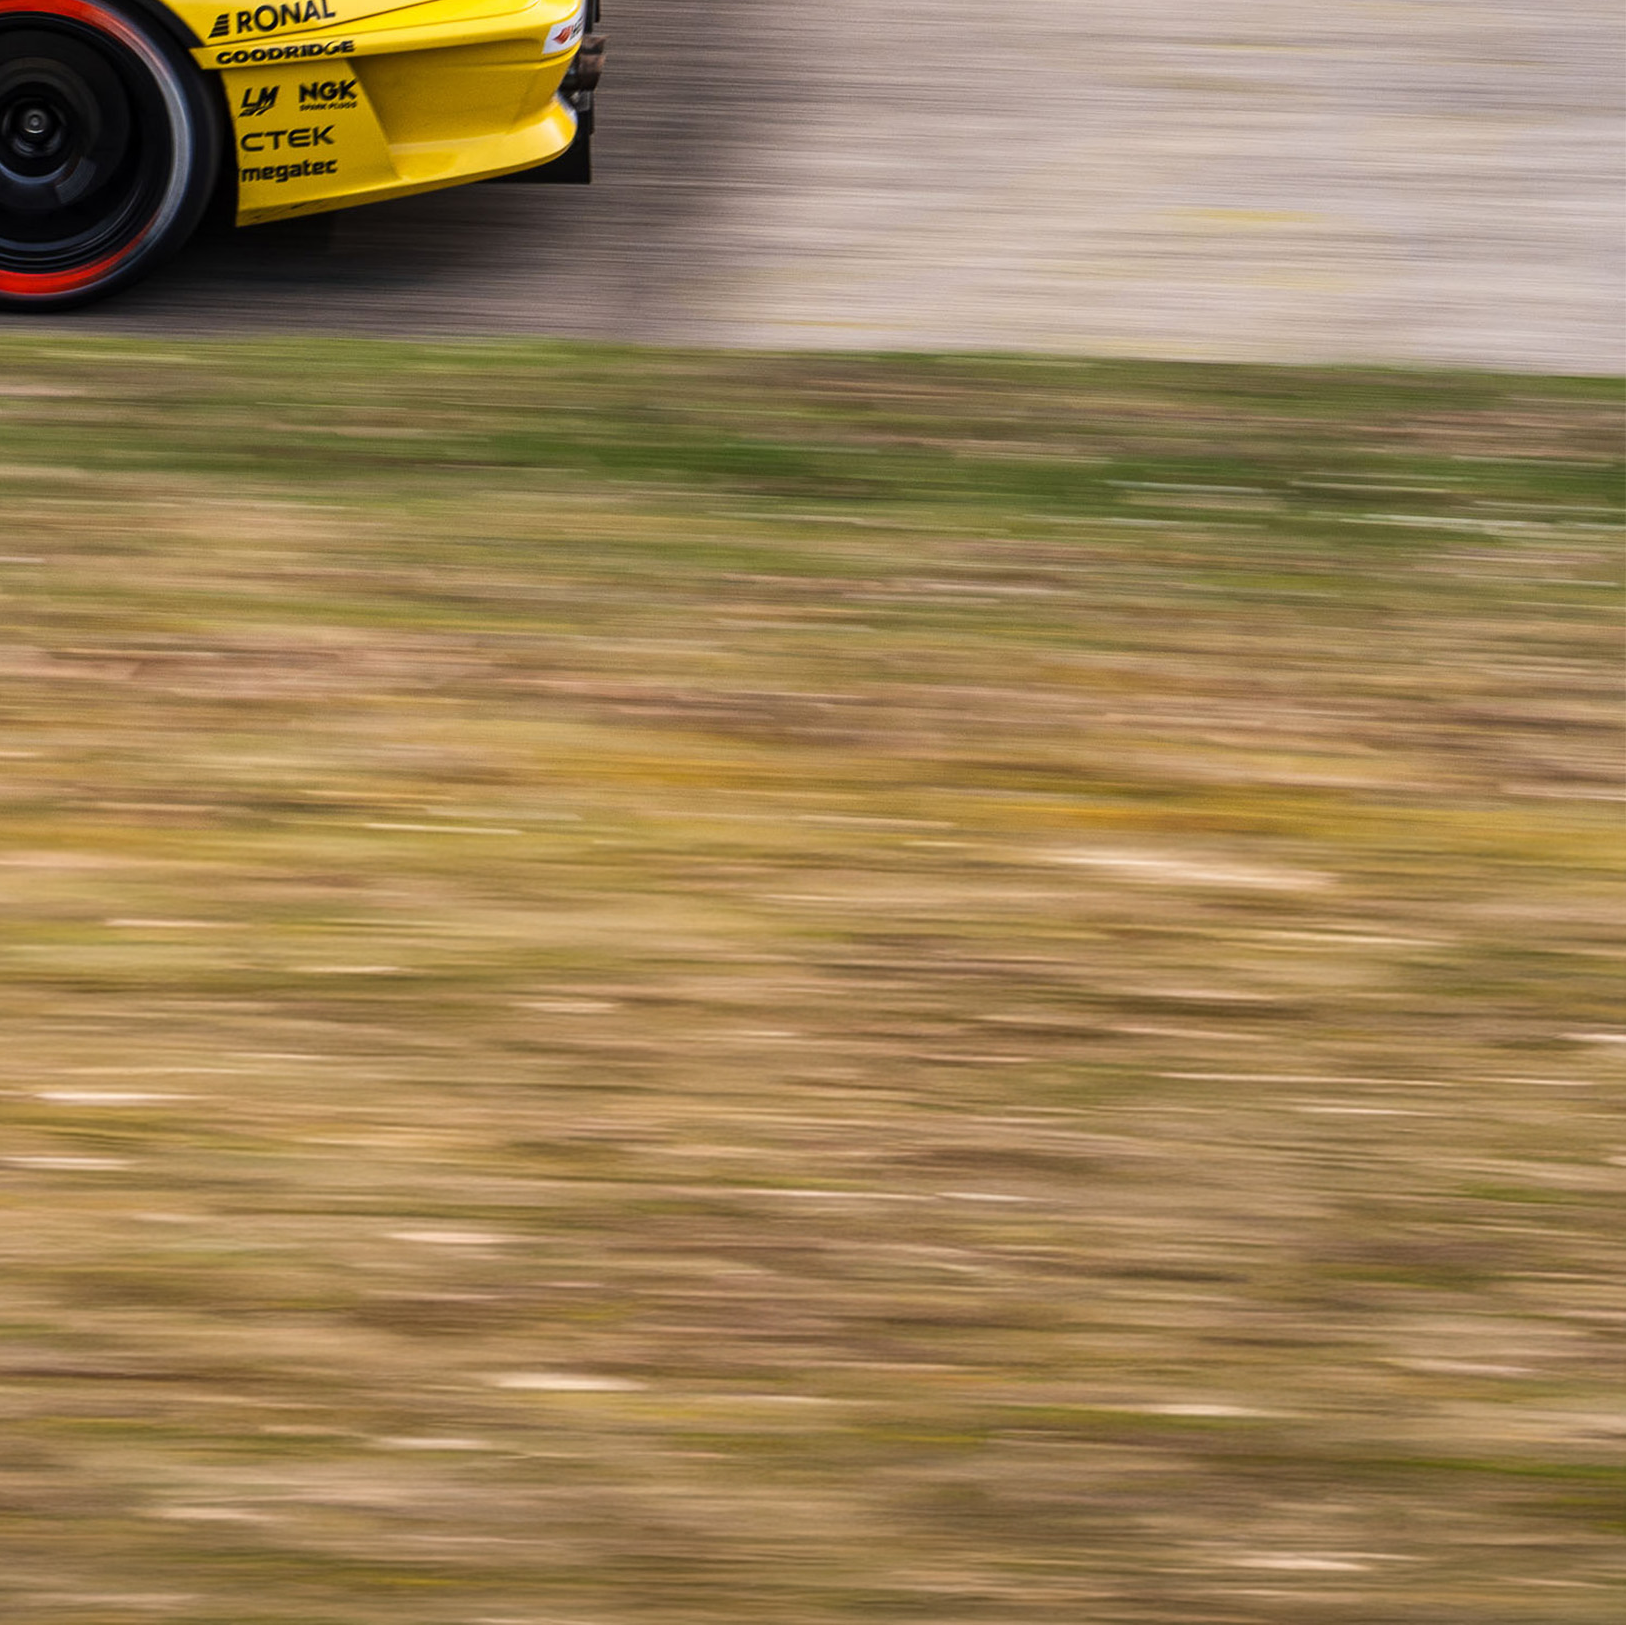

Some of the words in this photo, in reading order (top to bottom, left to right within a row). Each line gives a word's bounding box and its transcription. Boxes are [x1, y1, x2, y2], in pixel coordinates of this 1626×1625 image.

[216, 39, 356, 65] GOODRIDGE
[299, 78, 358, 103] NGK
[240, 125, 336, 153] CTEK
[240, 159, 338, 184] megatec
